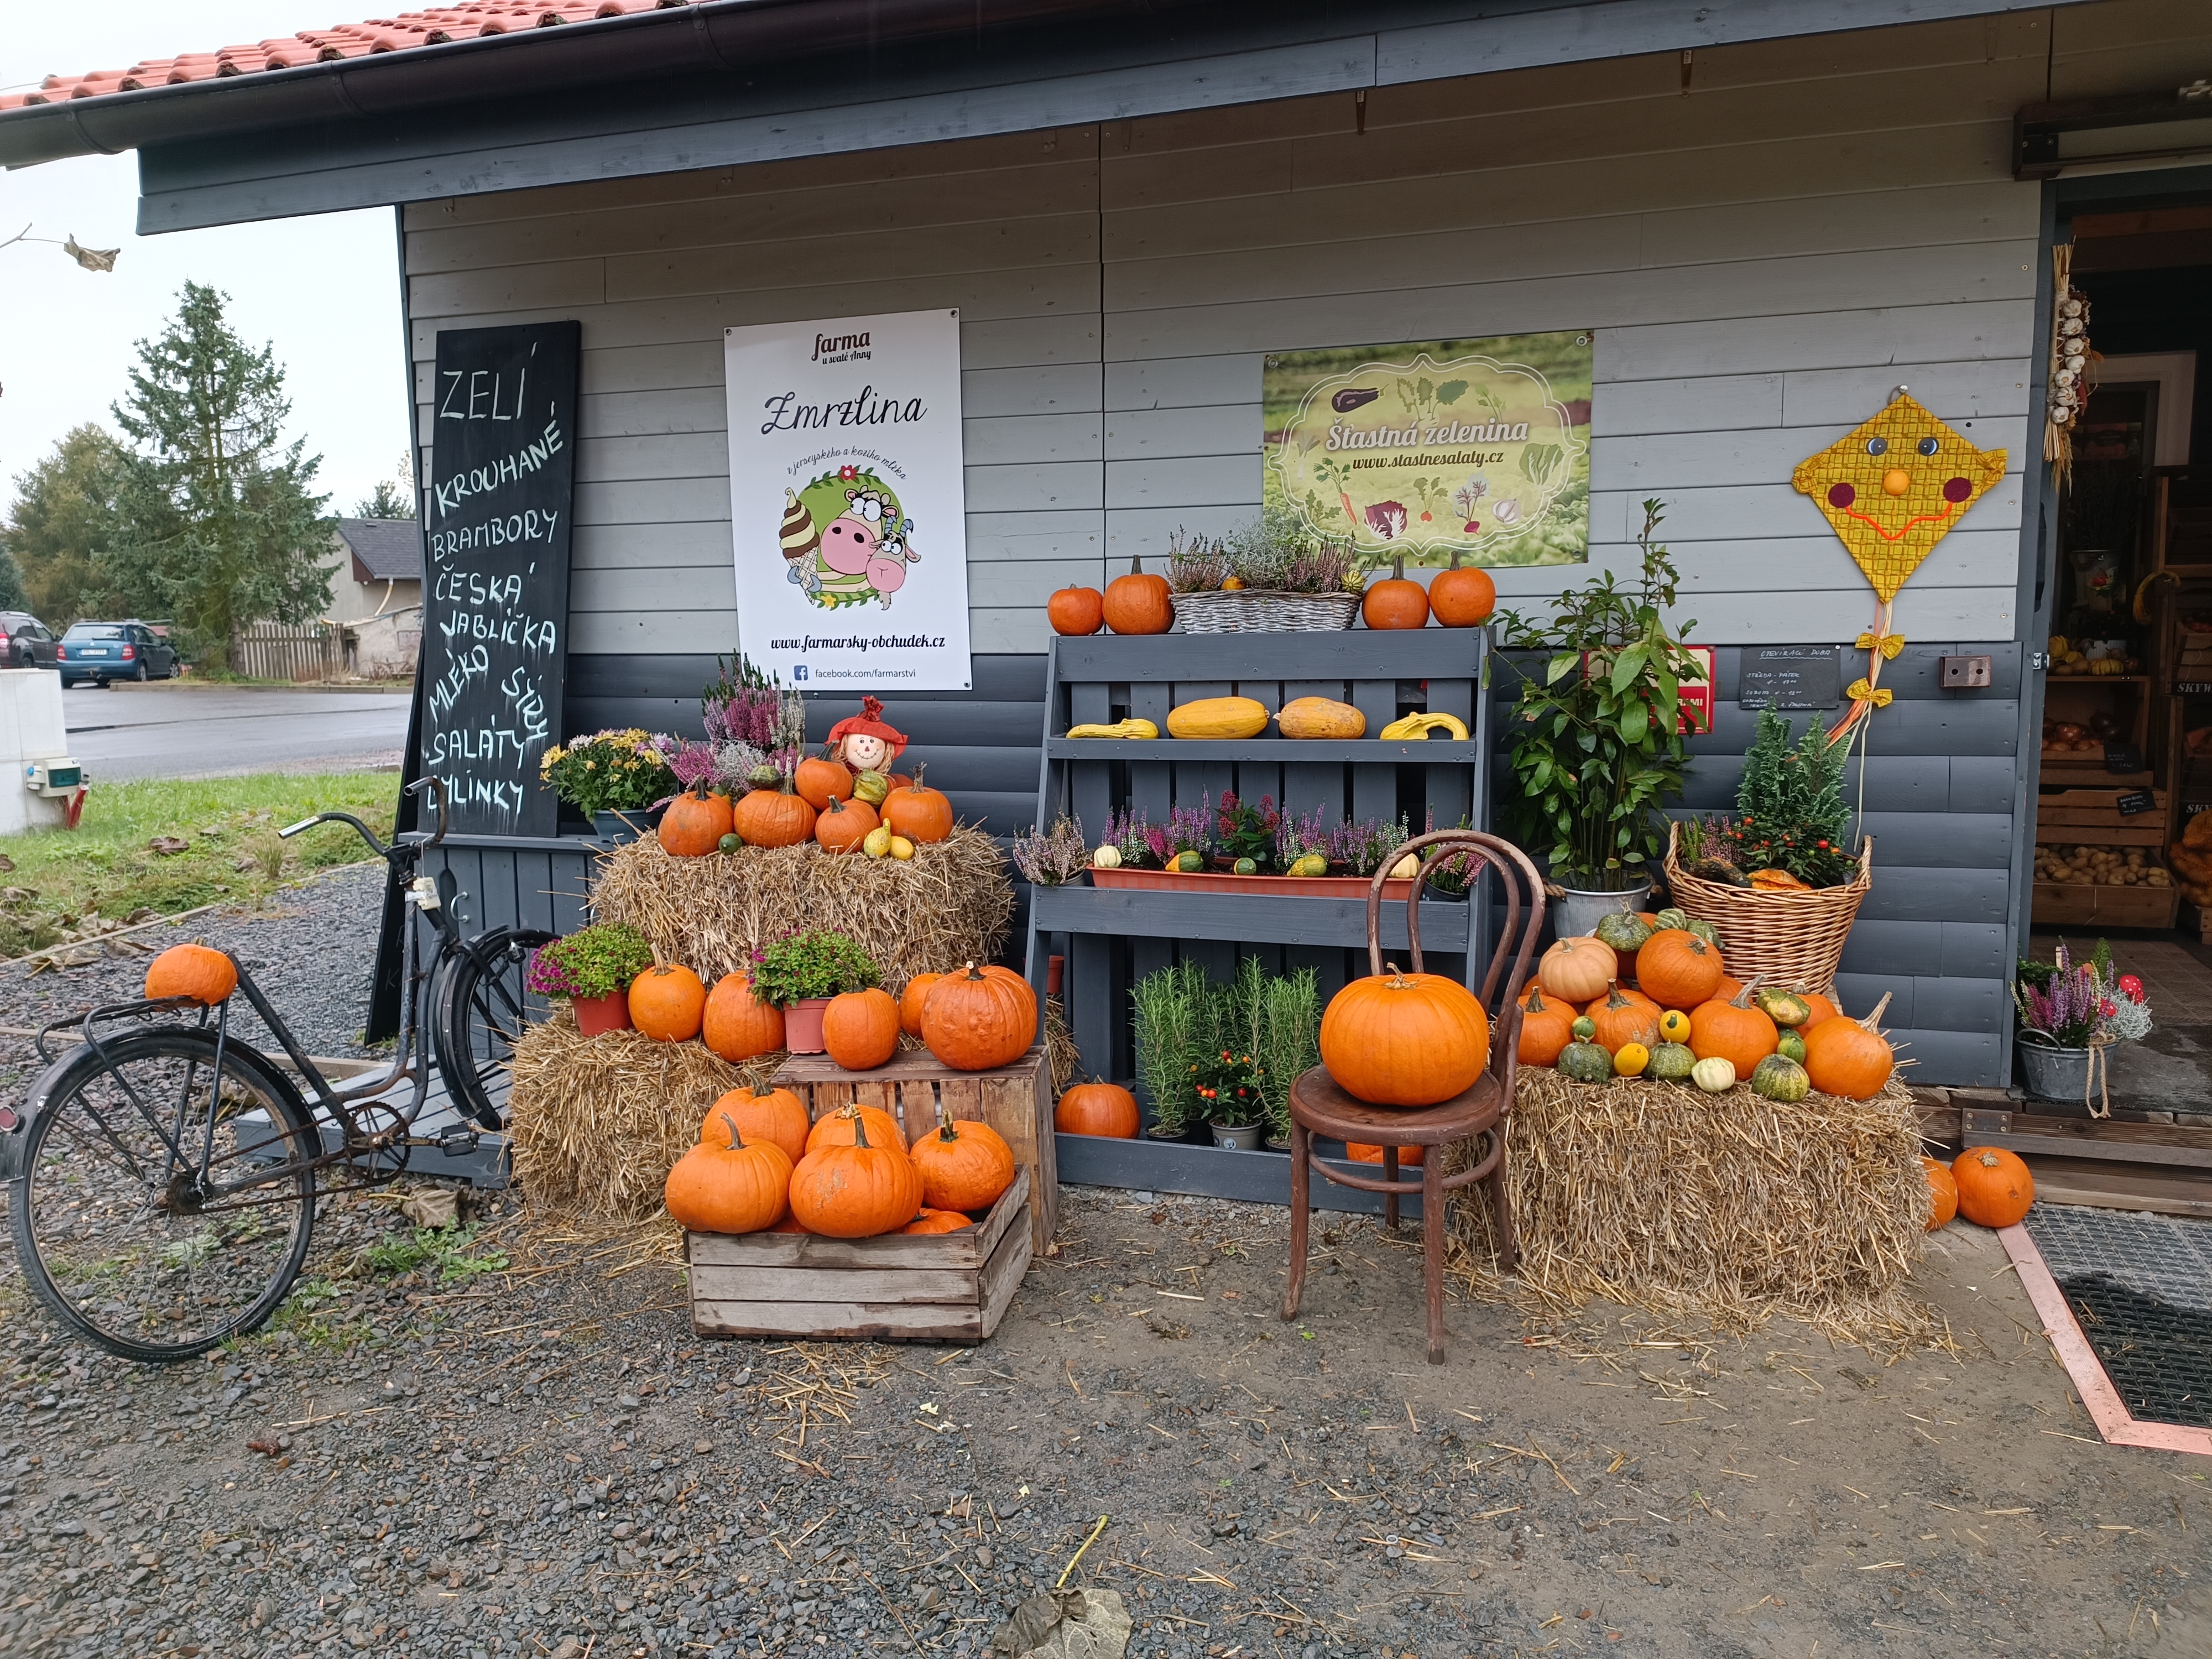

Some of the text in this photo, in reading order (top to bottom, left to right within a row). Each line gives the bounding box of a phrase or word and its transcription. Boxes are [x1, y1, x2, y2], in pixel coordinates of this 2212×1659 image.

[811, 332, 870, 361] farma
[829, 352, 848, 363] svaté
[850, 351, 871, 360] Anny
[440, 342, 538, 420] ZELÍ
[761, 385, 928, 435] Zmrzlina
[1326, 417, 1528, 451] Šťastná zelenina
[435, 401, 564, 518] KROUHANÉ
[851, 445, 880, 461] kozího
[881, 458, 906, 479] mléka
[1353, 451, 1504, 469] www.stastnesalaty.cz
[431, 508, 558, 563] BRAMBORY
[435, 562, 535, 604] ČESKÁ
[439, 607, 556, 654] JABLÍČKA
[771, 634, 945, 653] www.farmarsky-obchudek.cz
[429, 644, 489, 723] MLÉKO
[815, 669, 916, 678] facebook.com/farmarstvi
[501, 666, 549, 742] SÝRY
[428, 714, 526, 769] SALÁTY
